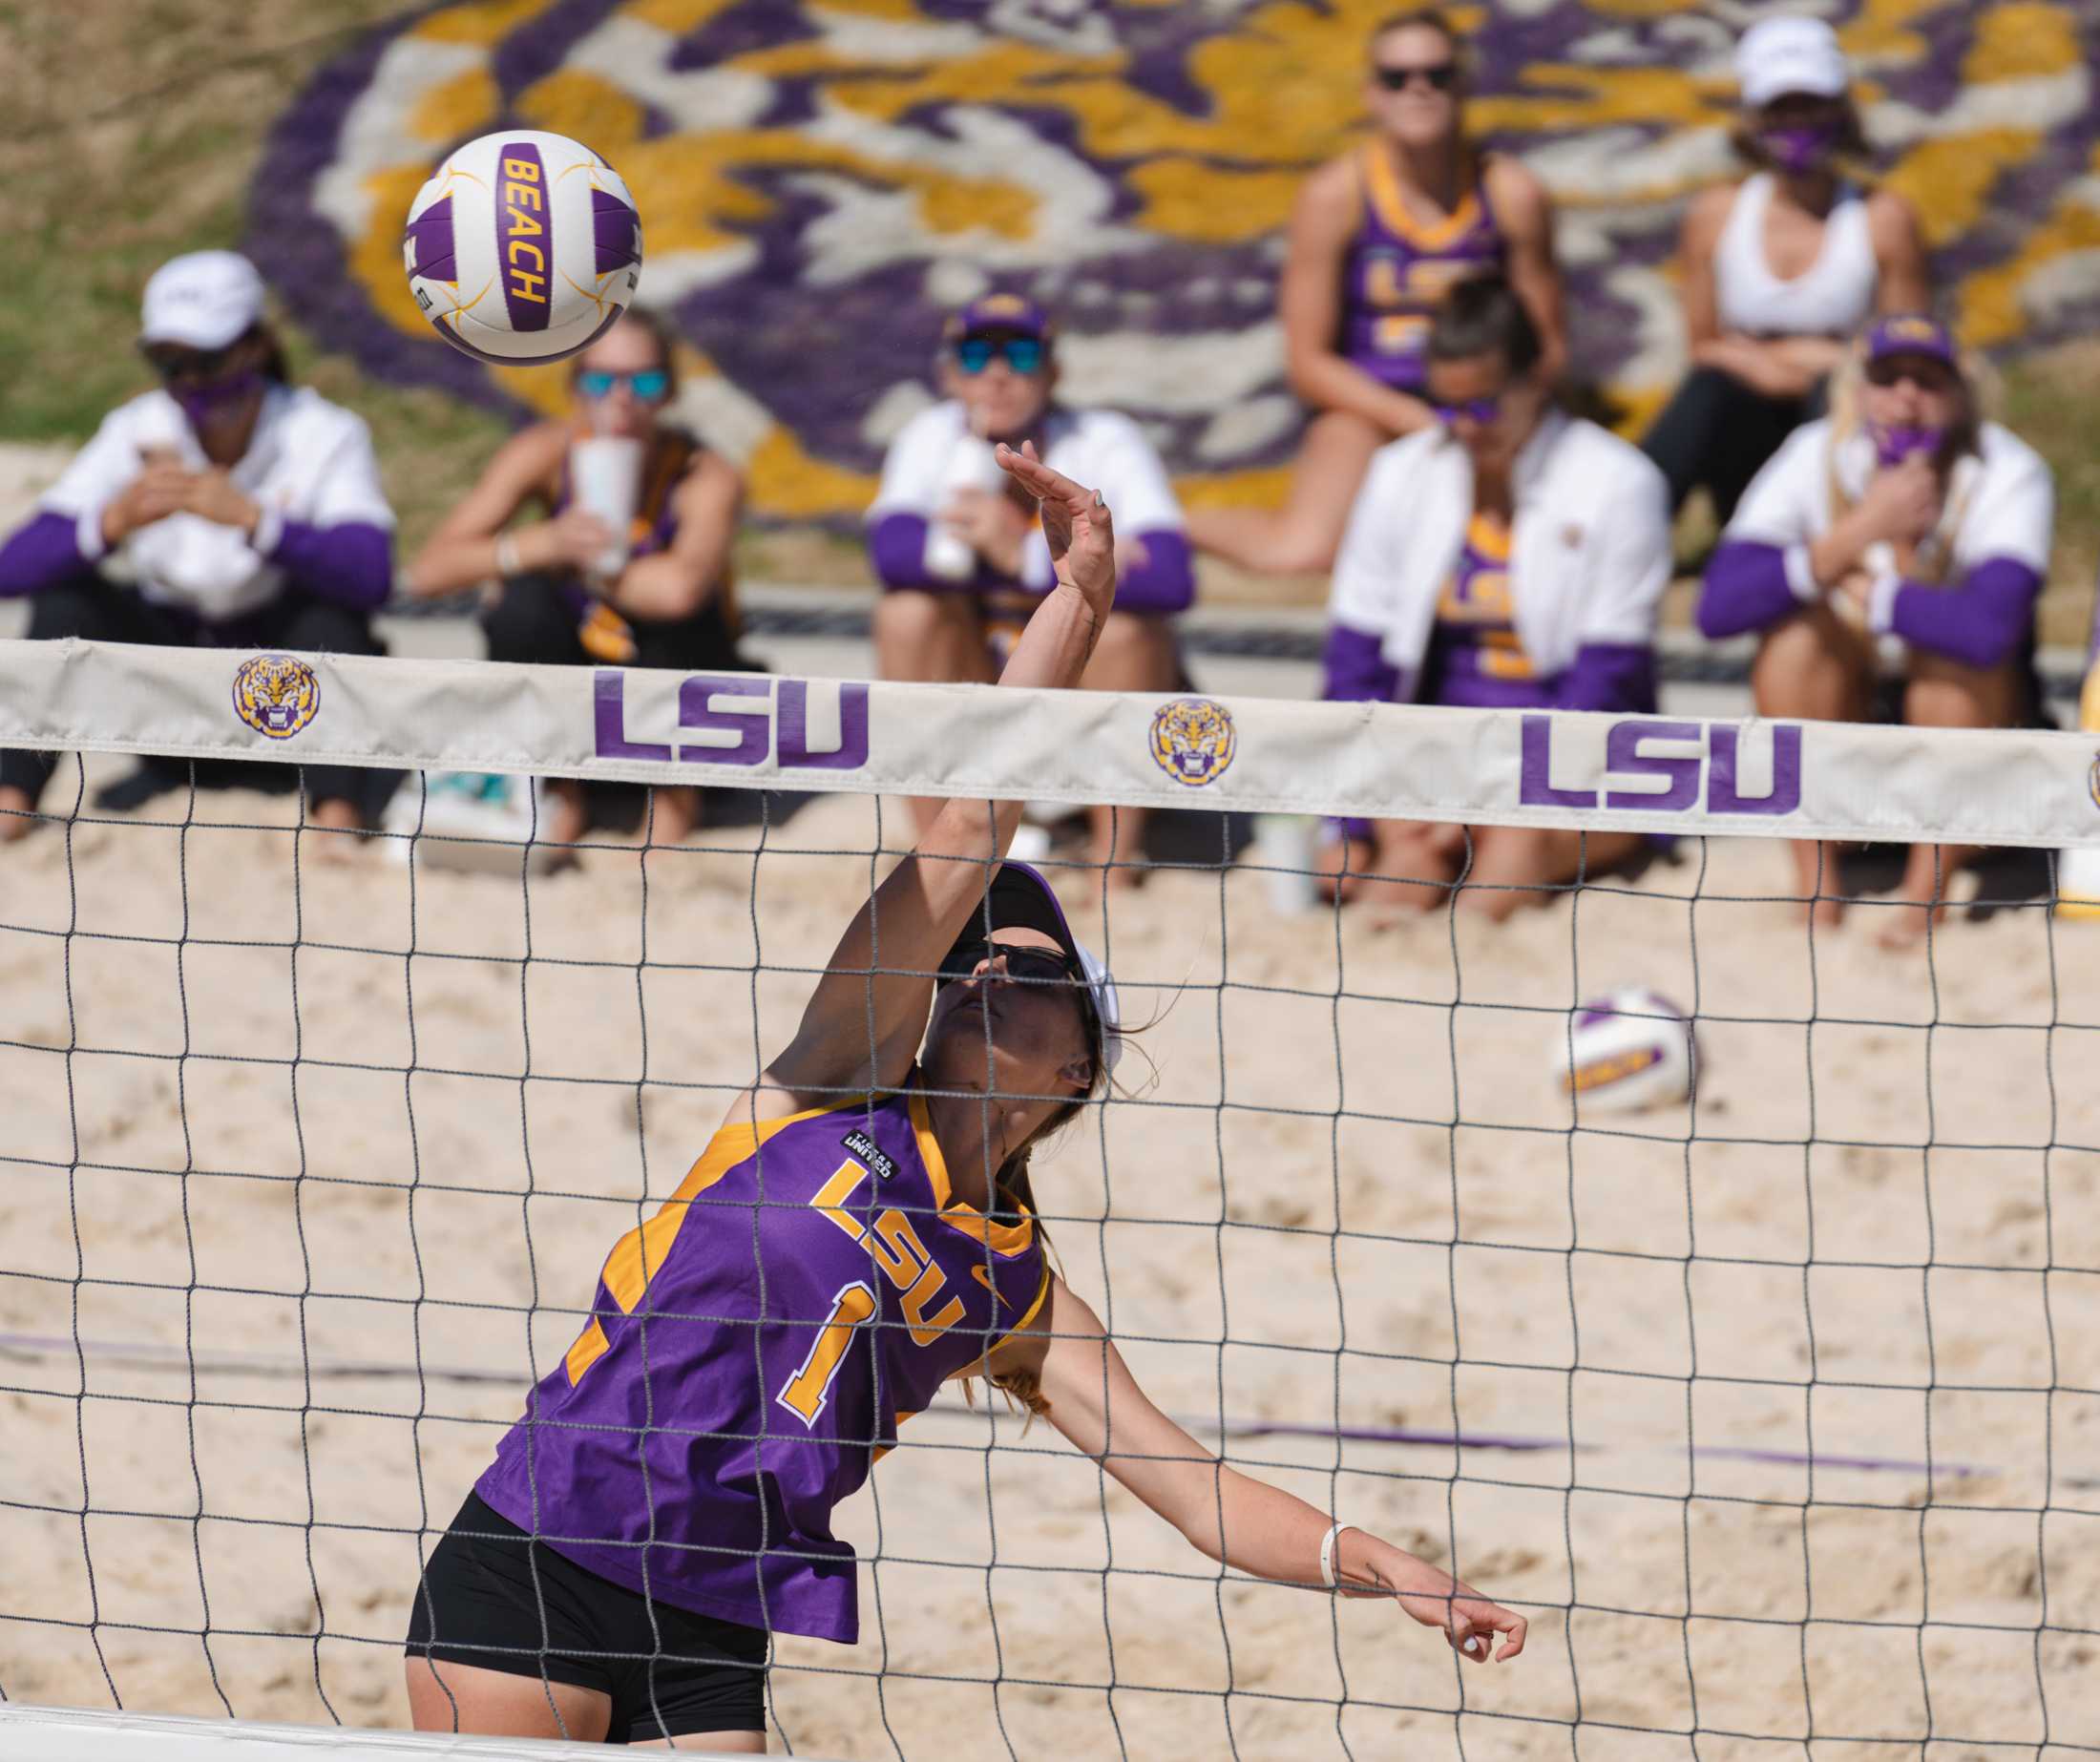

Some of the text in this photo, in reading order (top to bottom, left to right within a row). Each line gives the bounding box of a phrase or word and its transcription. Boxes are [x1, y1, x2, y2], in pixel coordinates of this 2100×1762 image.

[503, 157, 547, 304] BEACH
[594, 670, 870, 770] LSU
[1520, 714, 1802, 816] LSU
[844, 1136, 892, 1178] UNITED
[809, 1157, 967, 1347] LSU
[775, 1280, 880, 1430] 1
